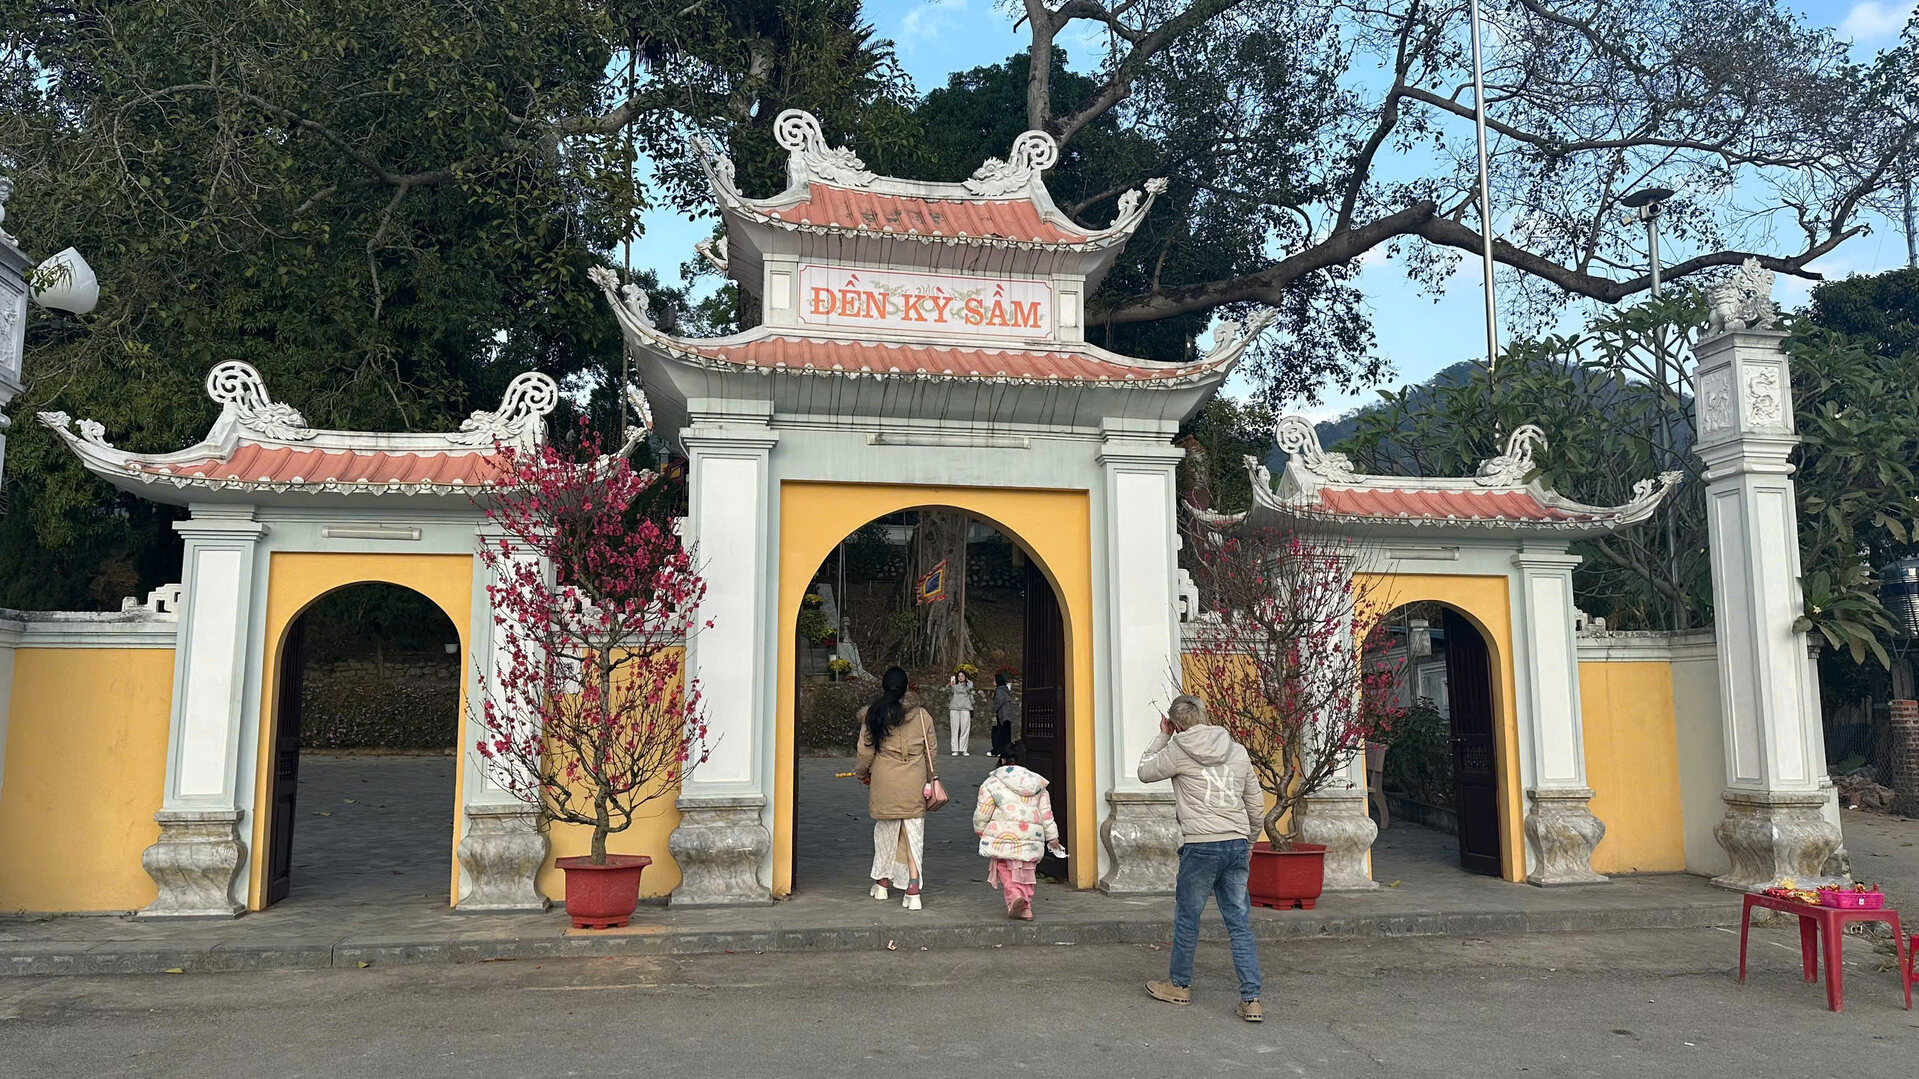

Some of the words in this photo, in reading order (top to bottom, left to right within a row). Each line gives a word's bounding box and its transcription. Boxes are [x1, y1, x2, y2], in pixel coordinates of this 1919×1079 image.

[810, 273, 890, 321] ĐỀN
[901, 286, 953, 324] KỲ
[964, 283, 1042, 329] SẦM
